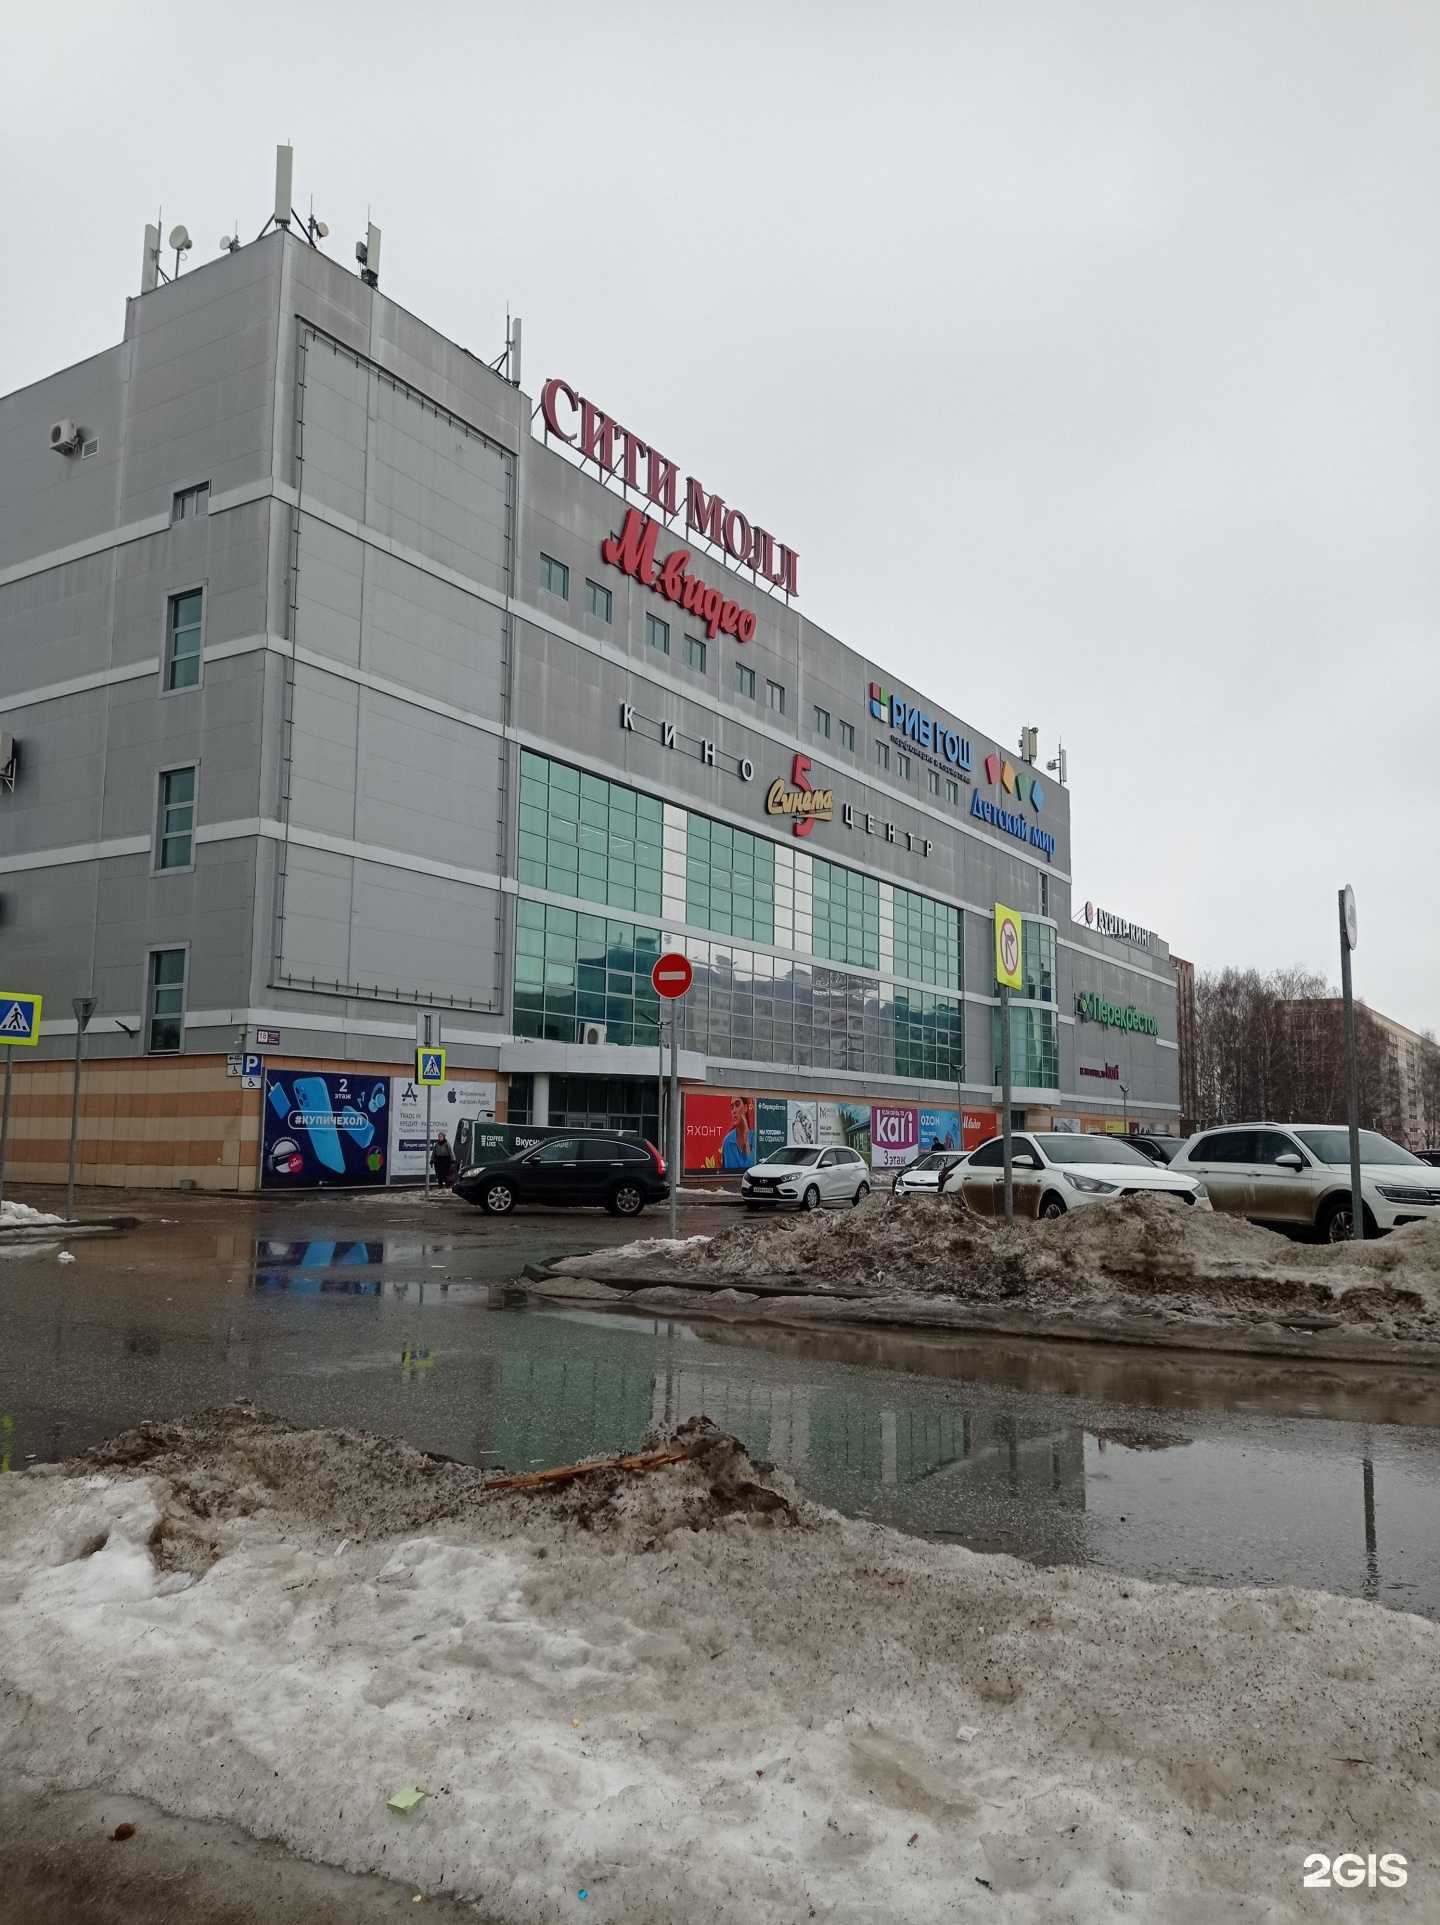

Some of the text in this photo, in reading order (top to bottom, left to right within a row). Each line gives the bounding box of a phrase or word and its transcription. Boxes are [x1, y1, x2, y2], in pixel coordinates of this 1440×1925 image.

[540, 378, 800, 598] СИТИ МОЛЛ
[890, 694, 973, 772] РИВ ГОШ
[620, 701, 933, 857] КИНО ЦЕНТР
[970, 788, 1057, 862] Детский мир
[339, 1078, 348, 1092] 2
[294, 1114, 364, 1126] #КУПИЧЕХОЛ
[686, 1125, 724, 1137] ЯХОНТ
[876, 1109, 913, 1143] kari
[883, 1150, 906, 1166] 3 этаж
